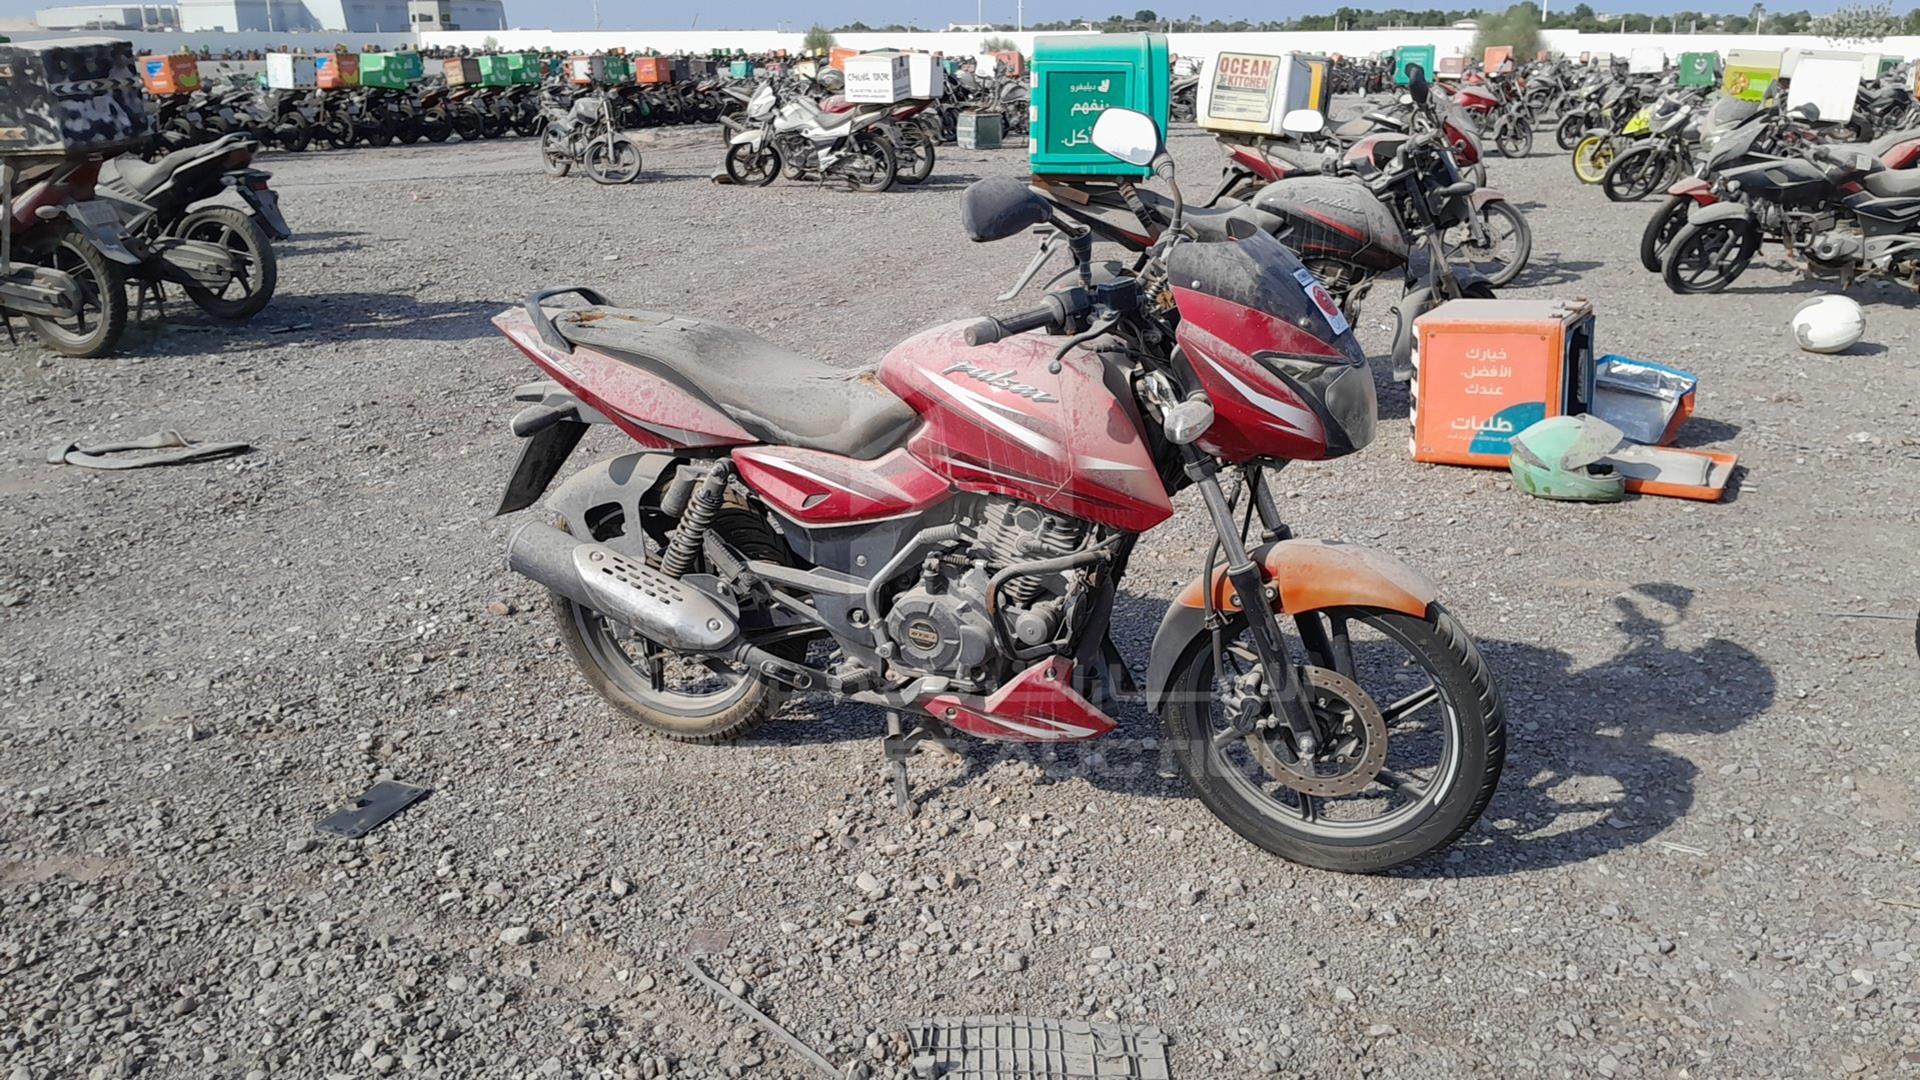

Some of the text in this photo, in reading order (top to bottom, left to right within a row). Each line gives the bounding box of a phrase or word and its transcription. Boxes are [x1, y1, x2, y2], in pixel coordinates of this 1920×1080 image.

[1219, 57, 1272, 77] OCEAN
[1227, 75, 1269, 89] KITCHEN
[1465, 347, 1507, 361] خيارك
[1464, 383, 1505, 396] عندك
[1451, 415, 1513, 435] طلبات
